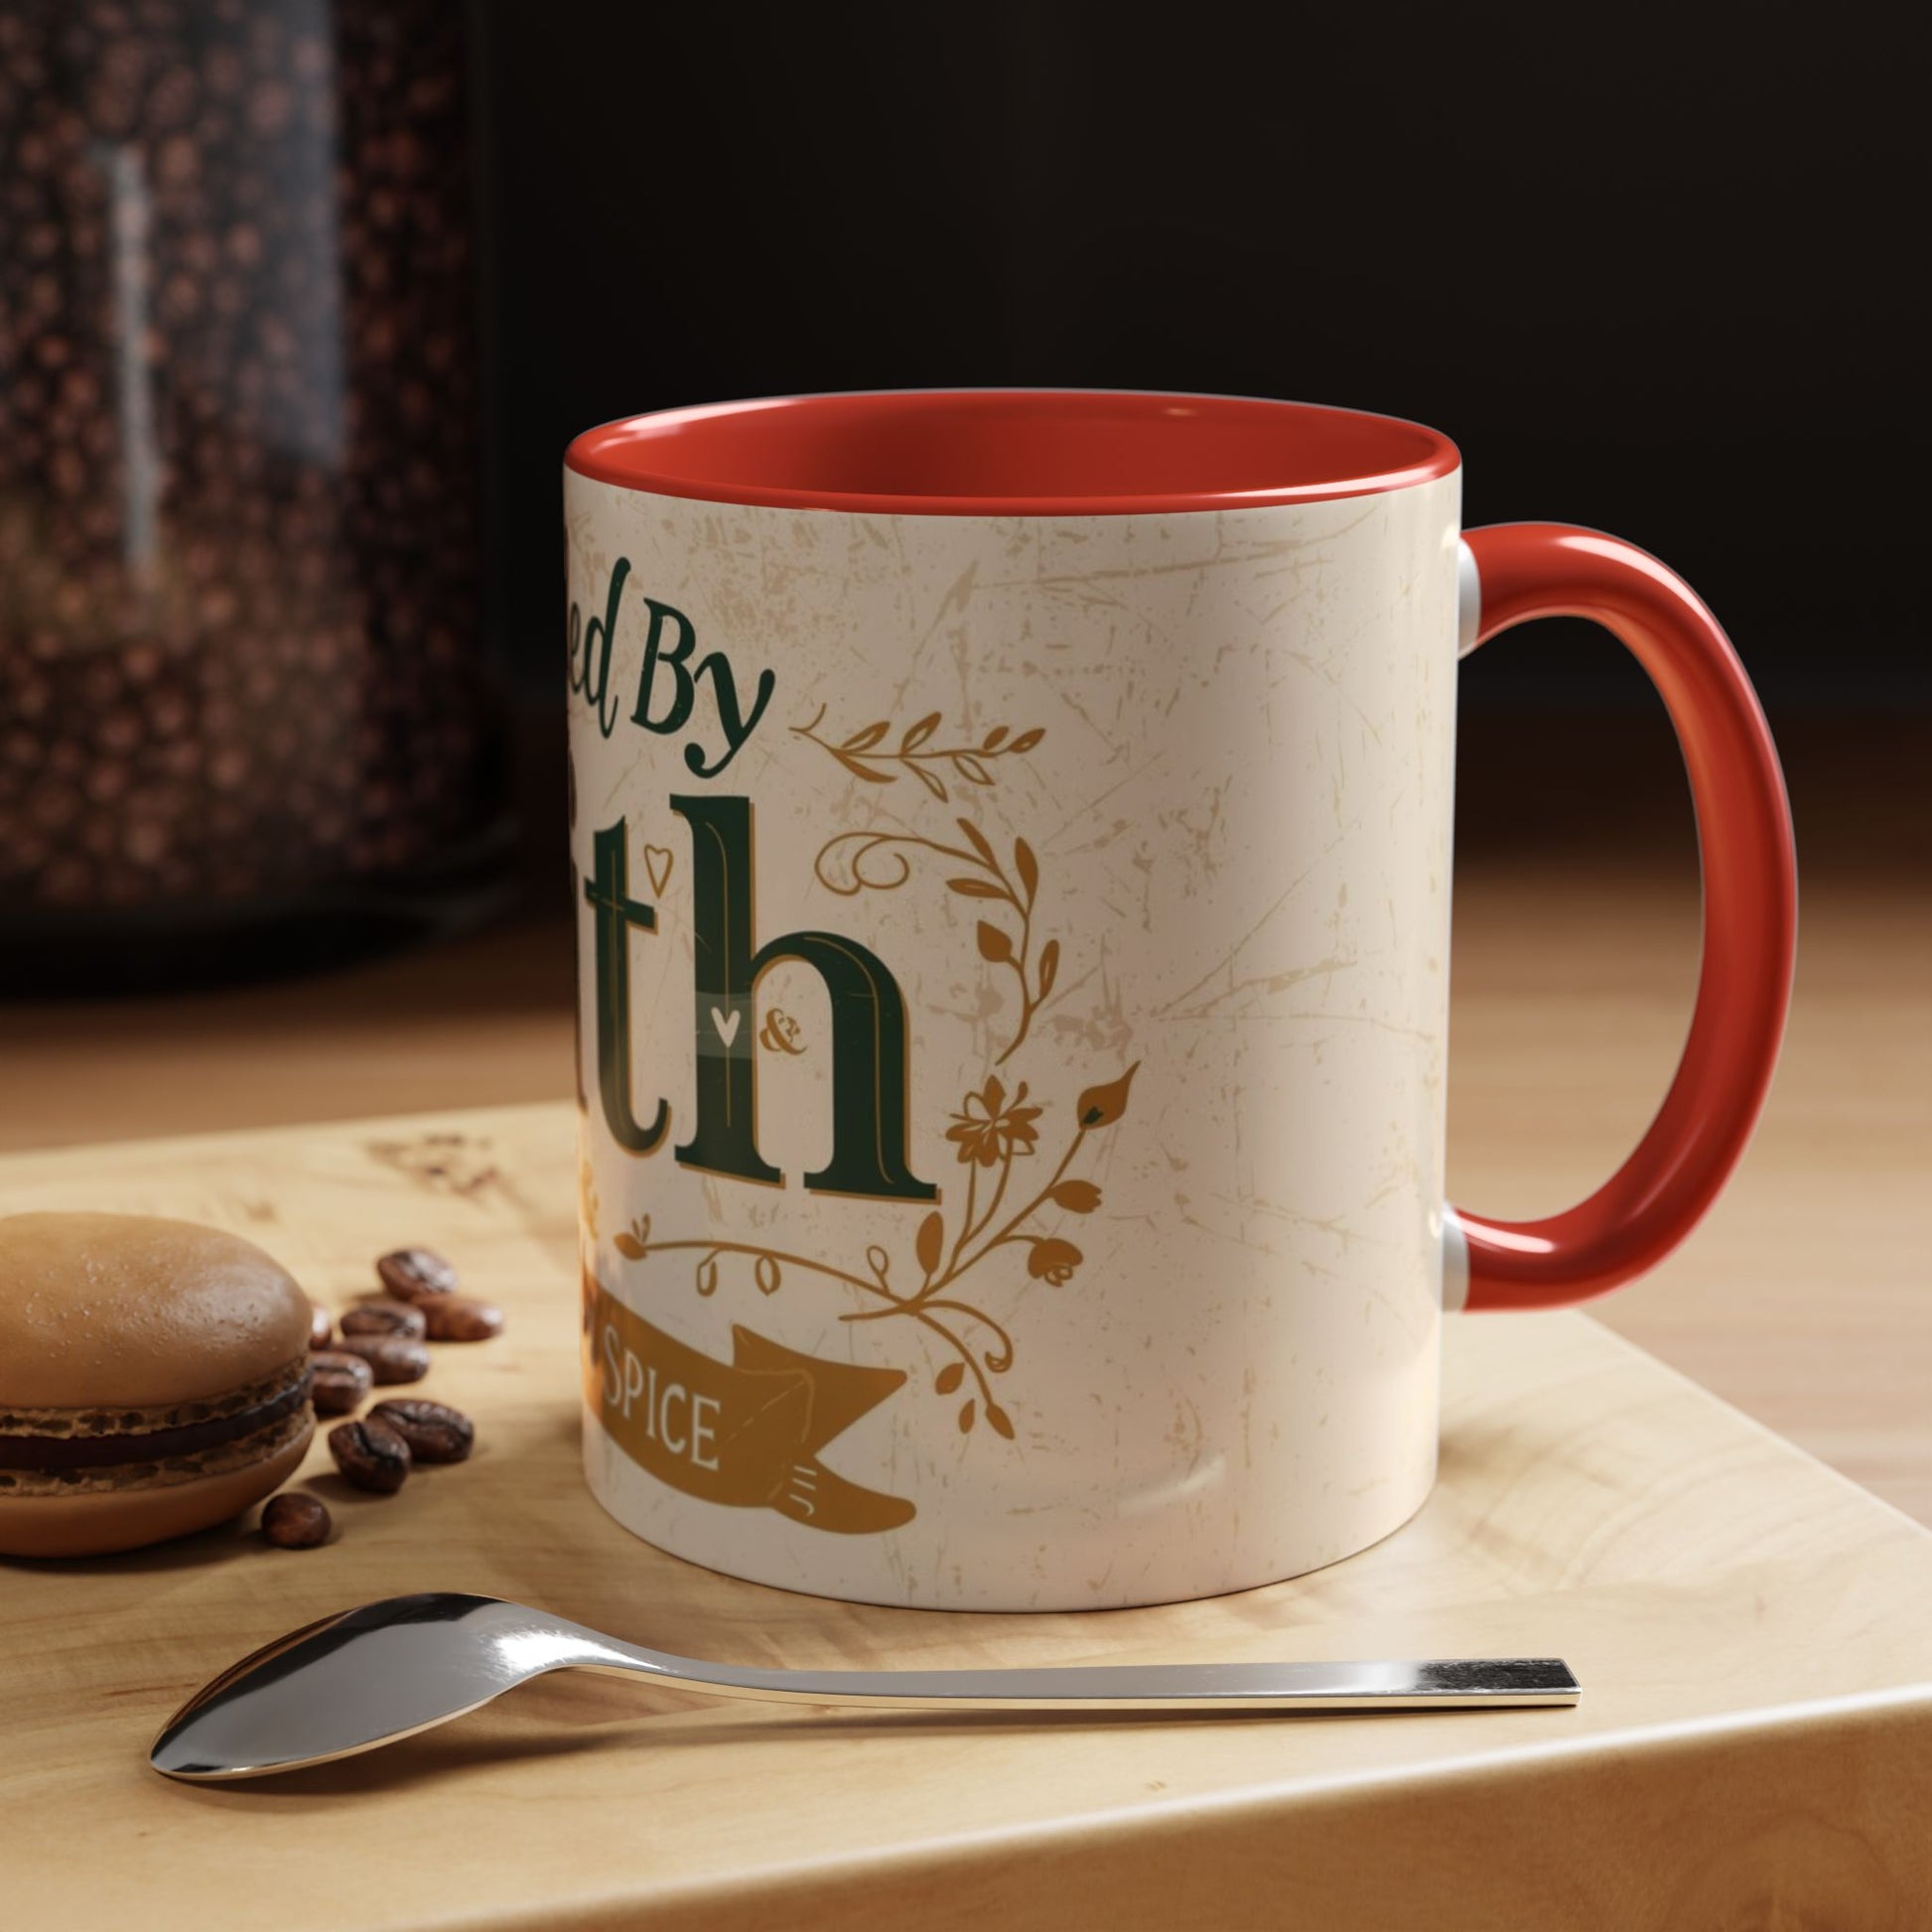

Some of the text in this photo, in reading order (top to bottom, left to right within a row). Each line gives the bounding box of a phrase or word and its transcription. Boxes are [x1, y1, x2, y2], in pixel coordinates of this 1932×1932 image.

[630, 597, 775, 778] By
[572, 793, 941, 1205] th
[759, 1008, 808, 1055] &
[603, 1323, 721, 1471] SPICE
